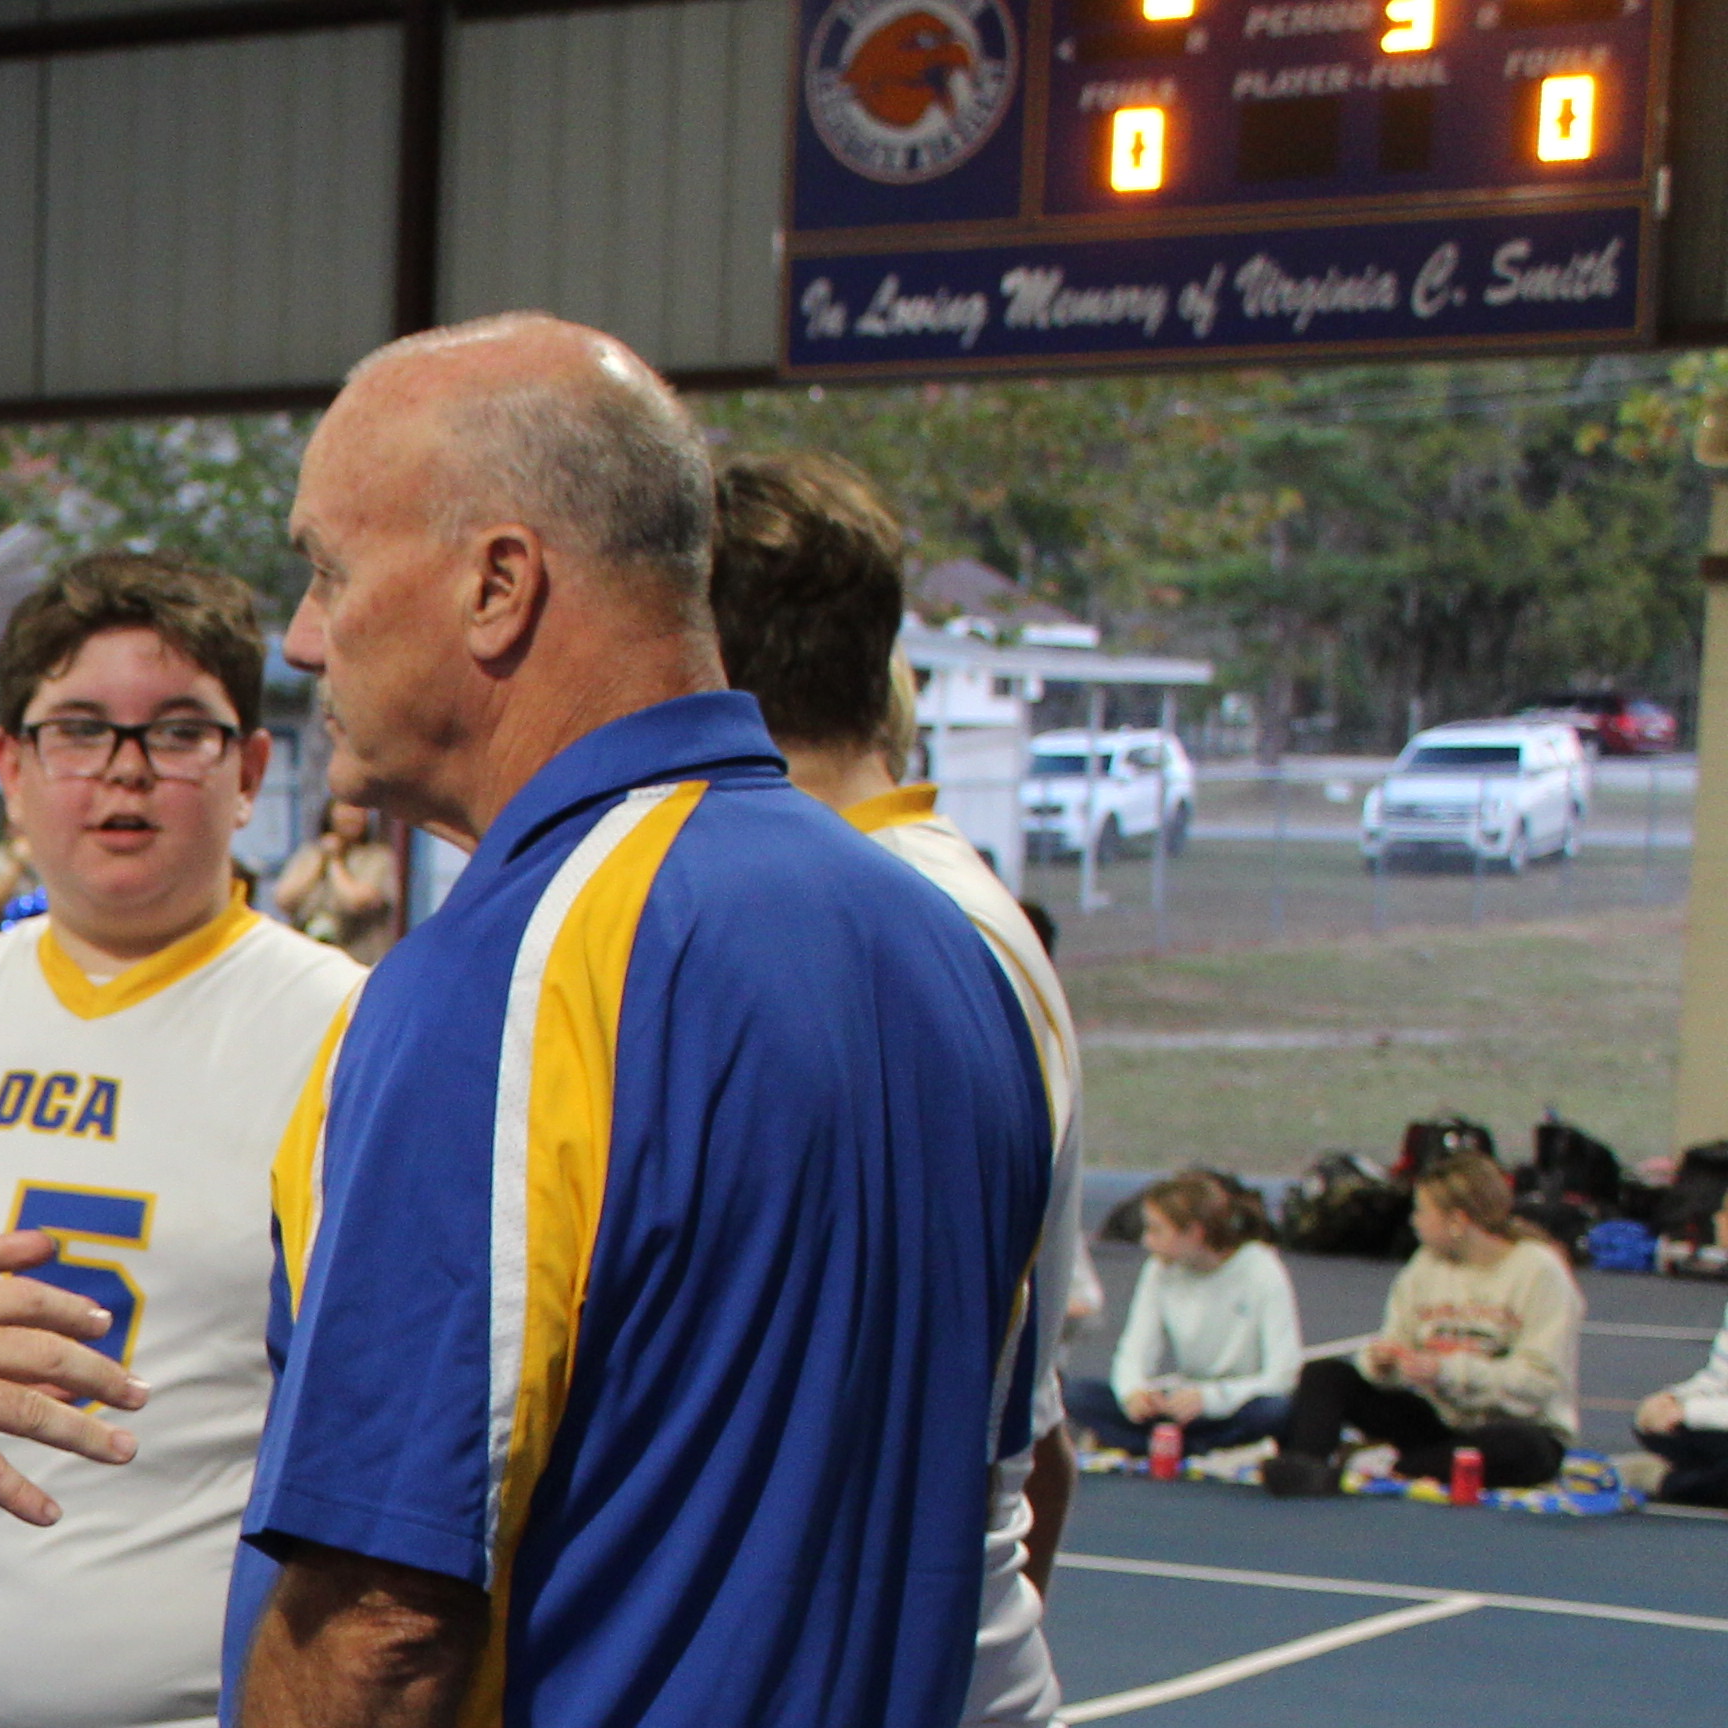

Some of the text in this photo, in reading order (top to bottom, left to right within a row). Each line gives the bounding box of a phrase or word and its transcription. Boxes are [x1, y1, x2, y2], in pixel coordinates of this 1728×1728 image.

[1110, 107, 1165, 192] 0
[1537, 74, 1595, 162] 0
[800, 236, 1625, 350] In Loving Memory of Virginia C. Smith
